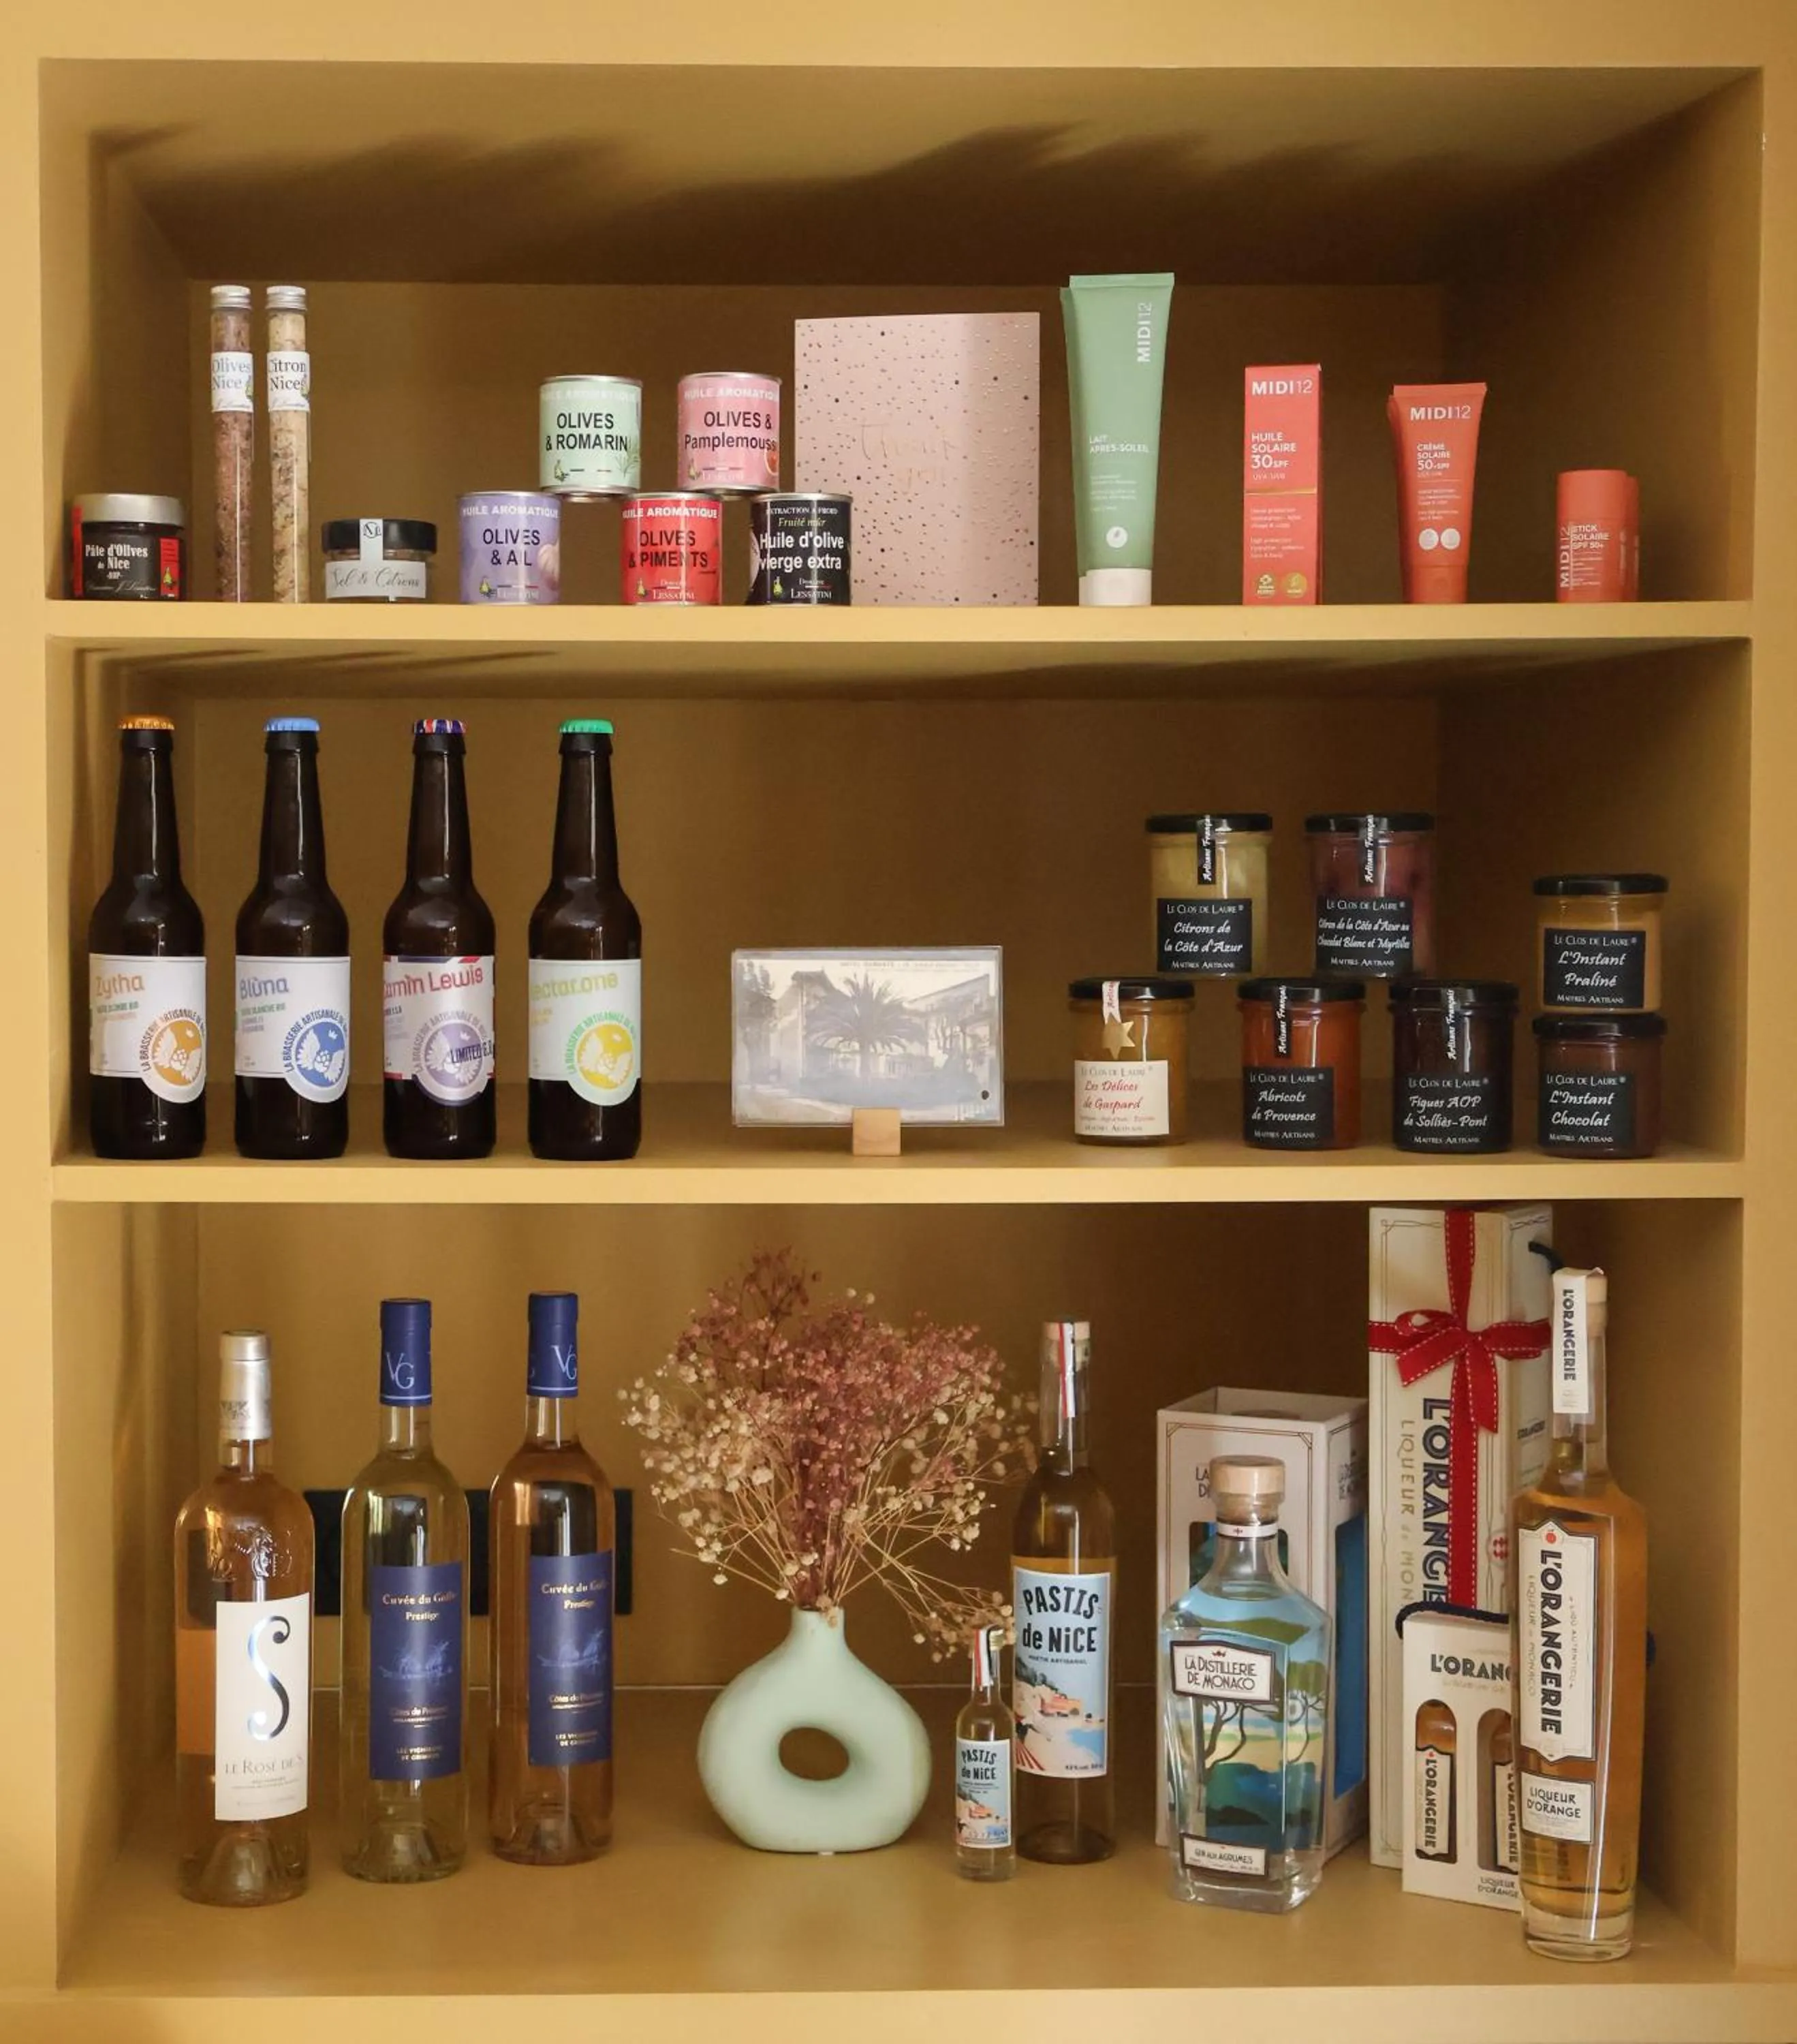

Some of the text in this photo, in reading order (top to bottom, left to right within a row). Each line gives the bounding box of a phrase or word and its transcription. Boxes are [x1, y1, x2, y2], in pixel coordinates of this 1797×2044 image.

[1137, 302, 1152, 362] MIDI12
[213, 376, 242, 389] Nice
[1252, 380, 1313, 396] MIDI12
[557, 412, 614, 429] OLIVES
[704, 411, 772, 430] OLIVES &
[1410, 405, 1471, 420] MIDI12
[546, 433, 627, 452] & ROMARIN
[1090, 435, 1108, 444] LAIT
[1251, 432, 1284, 442] HUILE
[1251, 443, 1296, 454] SOLAIRE
[1417, 451, 1450, 459] SOLAIRE
[646, 507, 717, 518] AROMATIQUE
[483, 529, 540, 546] OLIVES
[640, 530, 696, 546] OLIVES
[760, 530, 844, 549] Huile d'olive
[108, 544, 149, 558] d'Olives
[490, 550, 502, 566] &
[107, 557, 130, 570] Nice
[807, 553, 841, 570] extra
[1174, 920, 1232, 934] Citrons de
[1164, 938, 1244, 953] la Côte d'Azur
[1558, 950, 1627, 966] L'Instant
[428, 965, 484, 992] Lewis
[1564, 971, 1618, 987] Praliné
[1258, 1088, 1307, 1102] Abricots
[1549, 1090, 1615, 1105] L'Instant
[1095, 1096, 1143, 1114] Gaspard
[1409, 1095, 1482, 1114] Figues AOP
[1251, 1106, 1317, 1121] de Provence
[1551, 1110, 1611, 1126] Chocolat
[1563, 1288, 1576, 1381] L'ORANGERIE
[541, 1581, 589, 1596] Cuvée du
[382, 1592, 431, 1606] Cuvée du
[1023, 1585, 1099, 1620] PASTIS
[1022, 1615, 1043, 1650] de
[1540, 1549, 1562, 1735] L'ORANGERIE
[1185, 1656, 1257, 1677] LA DISTILLERIE
[1187, 1671, 1255, 1691] DE MONACO
[962, 1749, 997, 1765] PASTIS
[1424, 1759, 1437, 1848] L'ORANGERIE
[1530, 1787, 1576, 1805] LIQUEUR
[1527, 1798, 1581, 1818] D'ORANGE
